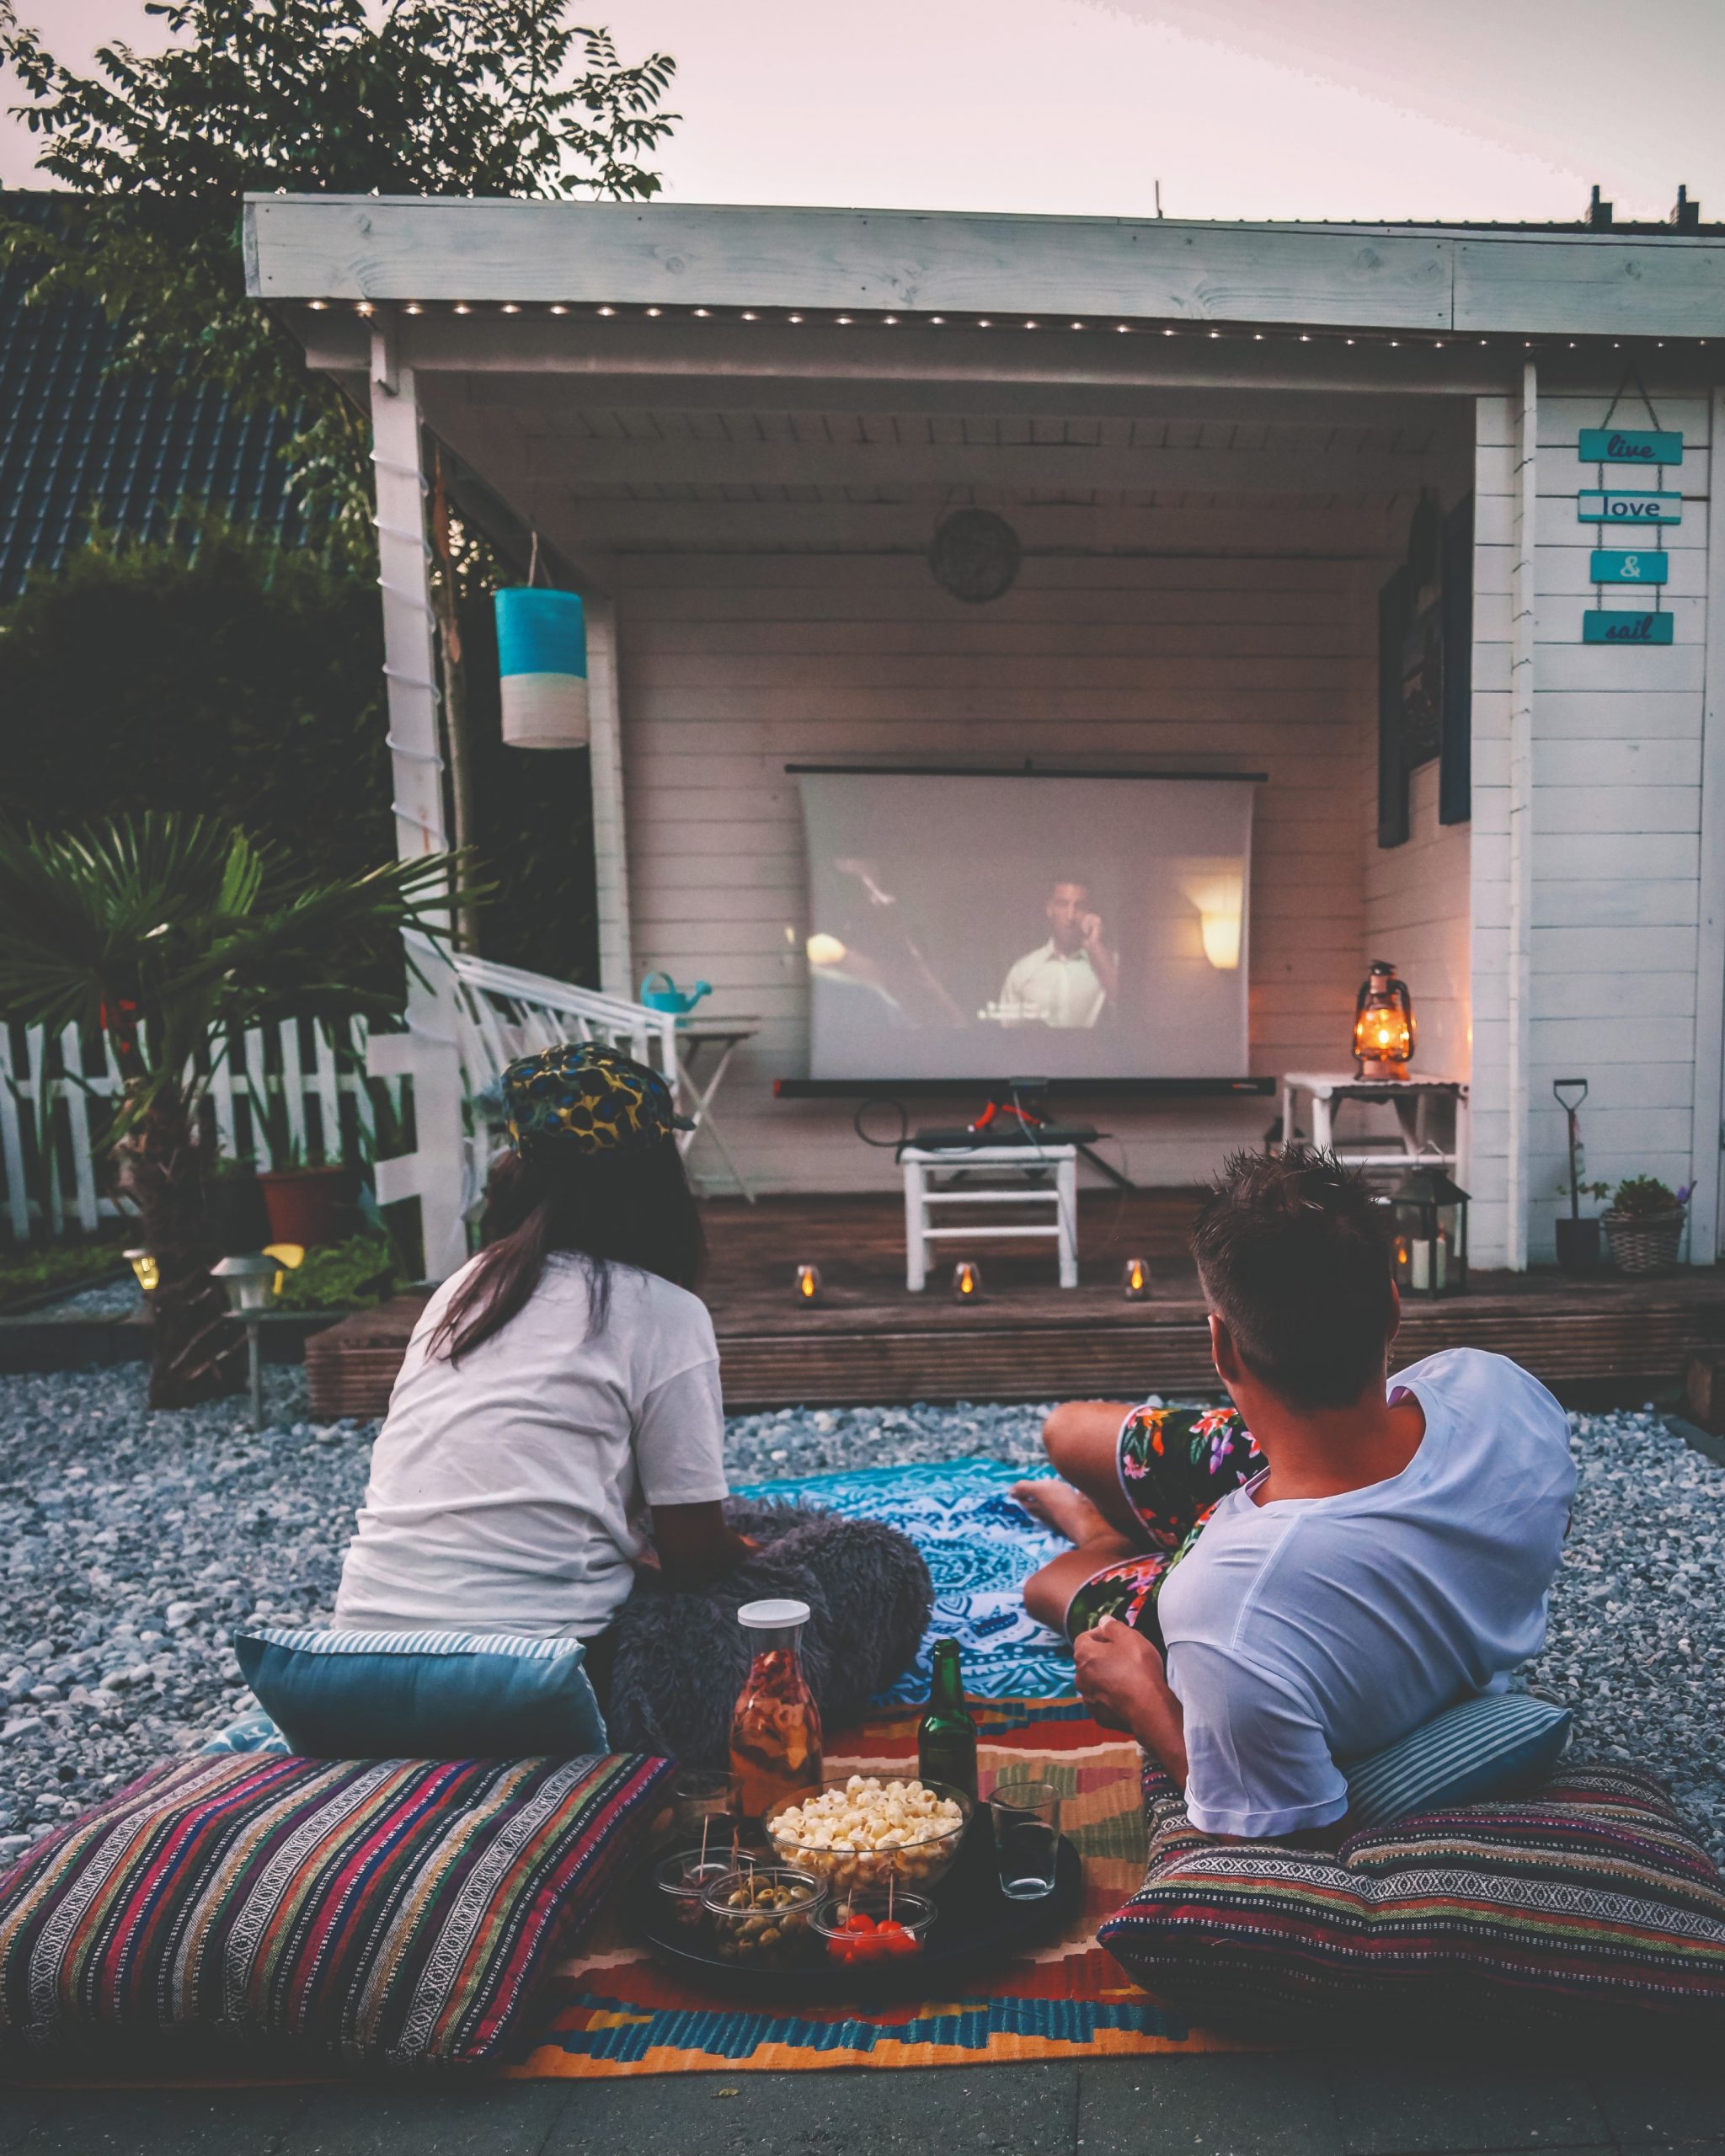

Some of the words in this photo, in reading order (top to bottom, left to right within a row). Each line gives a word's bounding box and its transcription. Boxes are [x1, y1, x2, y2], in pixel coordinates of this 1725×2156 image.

[1607, 434, 1656, 459] live
[1603, 496, 1660, 517] love
[1620, 555, 1641, 578] &
[1605, 615, 1653, 640] sail
